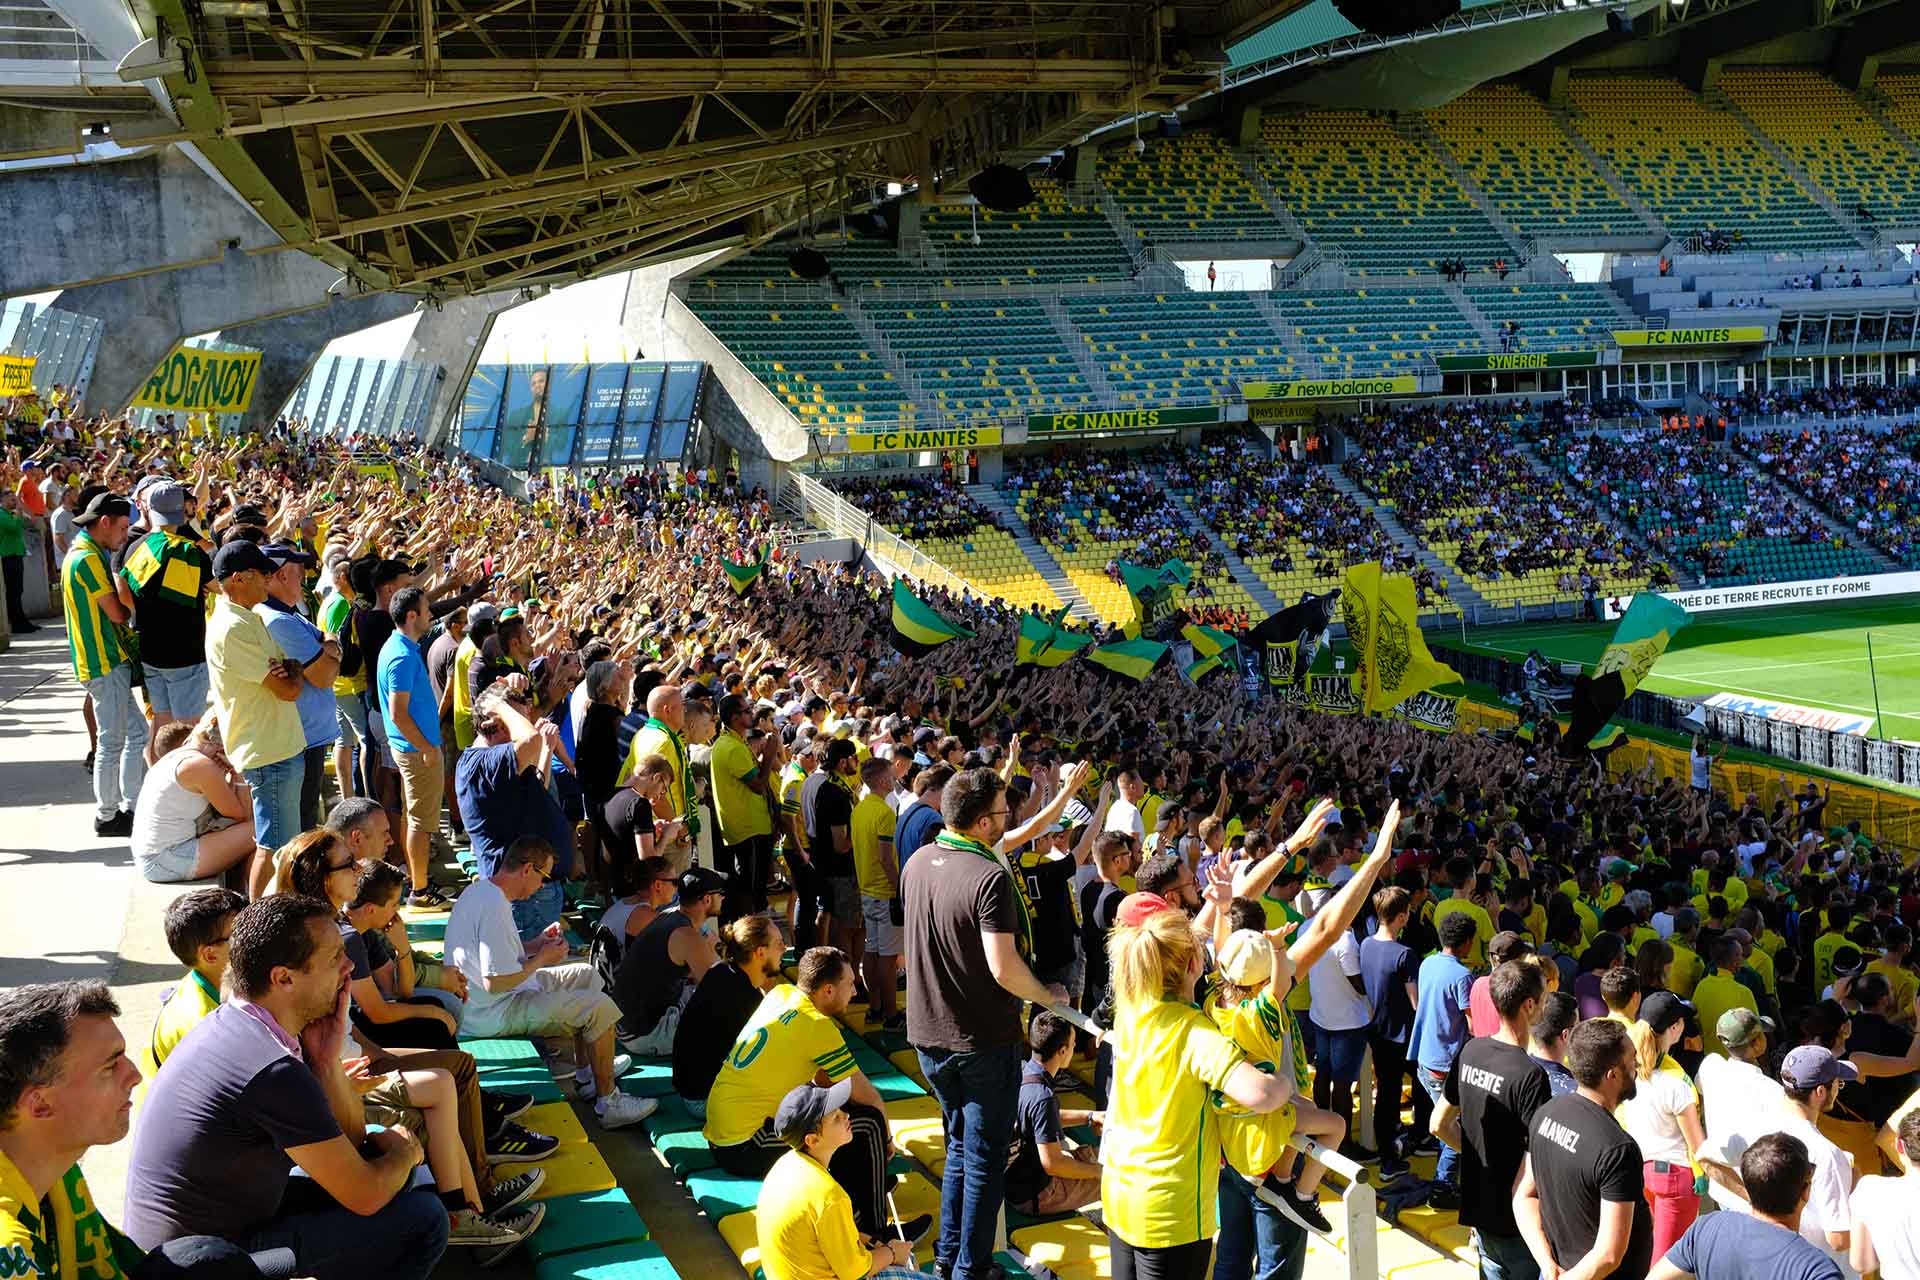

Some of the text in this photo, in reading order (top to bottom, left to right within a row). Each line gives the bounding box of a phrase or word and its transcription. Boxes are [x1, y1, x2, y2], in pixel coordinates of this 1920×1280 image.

[1647, 329, 1730, 345] FC NANTES
[1487, 354, 1548, 369] SYNERGIE
[1297, 384, 1328, 396] new
[1331, 381, 1393, 395] balance
[1053, 410, 1159, 432] FC NANTES
[873, 430, 978, 449] FC NANTES
[1672, 581, 1871, 608] RMÉE DE TERRE RECRUTE ET FORME
[1461, 1064, 1504, 1095] VICENTE
[1538, 1116, 1580, 1154] MANUEL
